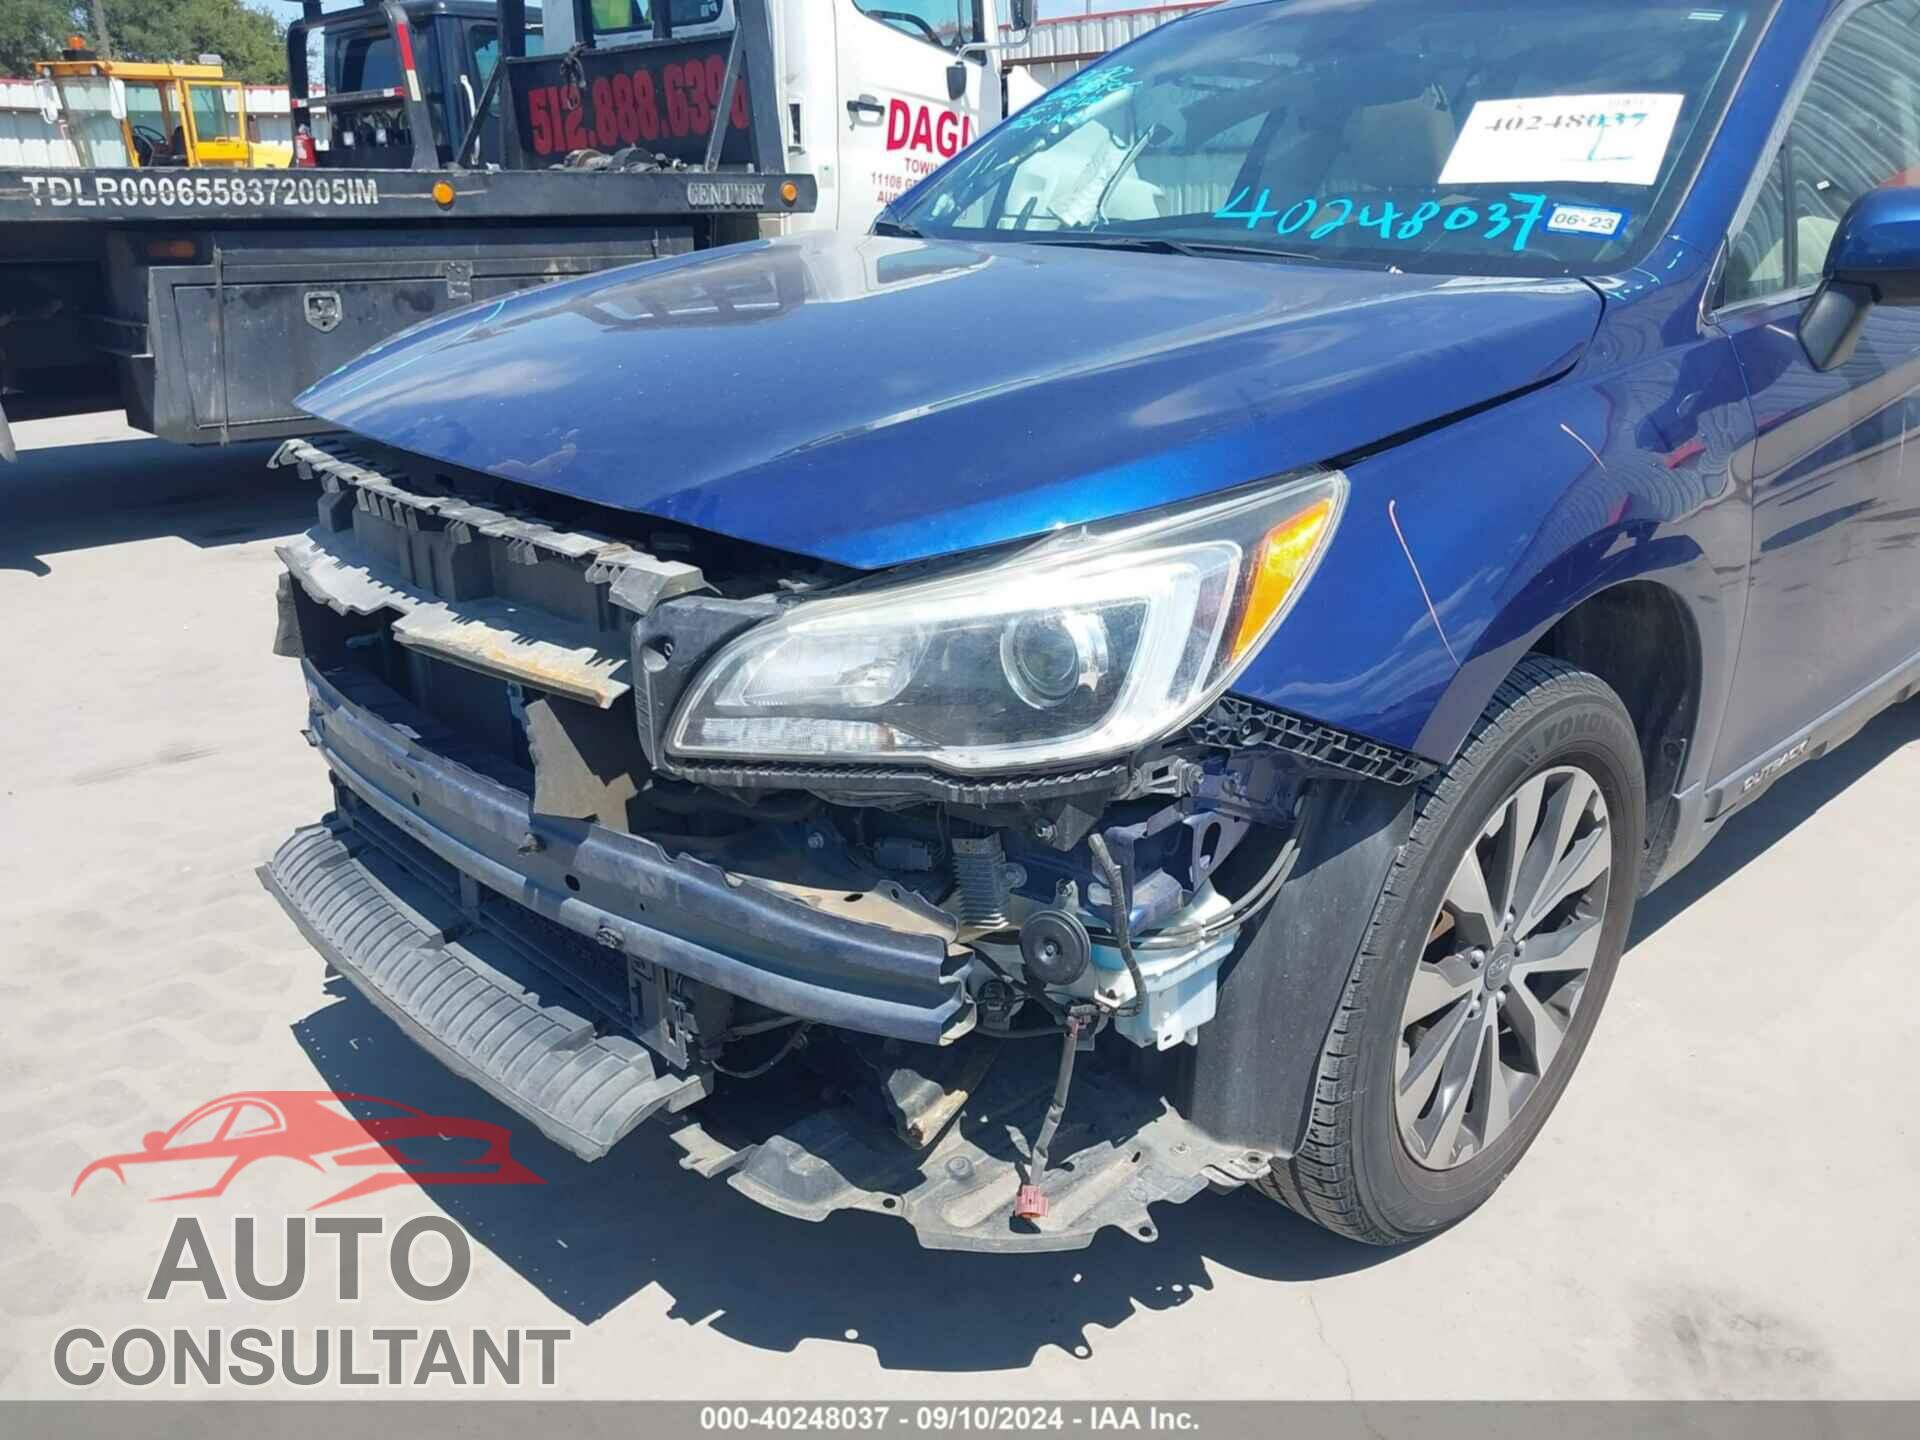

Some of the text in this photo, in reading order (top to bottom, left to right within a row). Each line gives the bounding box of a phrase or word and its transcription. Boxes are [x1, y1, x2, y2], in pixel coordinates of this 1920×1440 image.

[22, 176, 380, 207] TDLR0006558372005IM
[686, 182, 767, 208] CENTURY
[1213, 186, 1547, 252] 40248037
